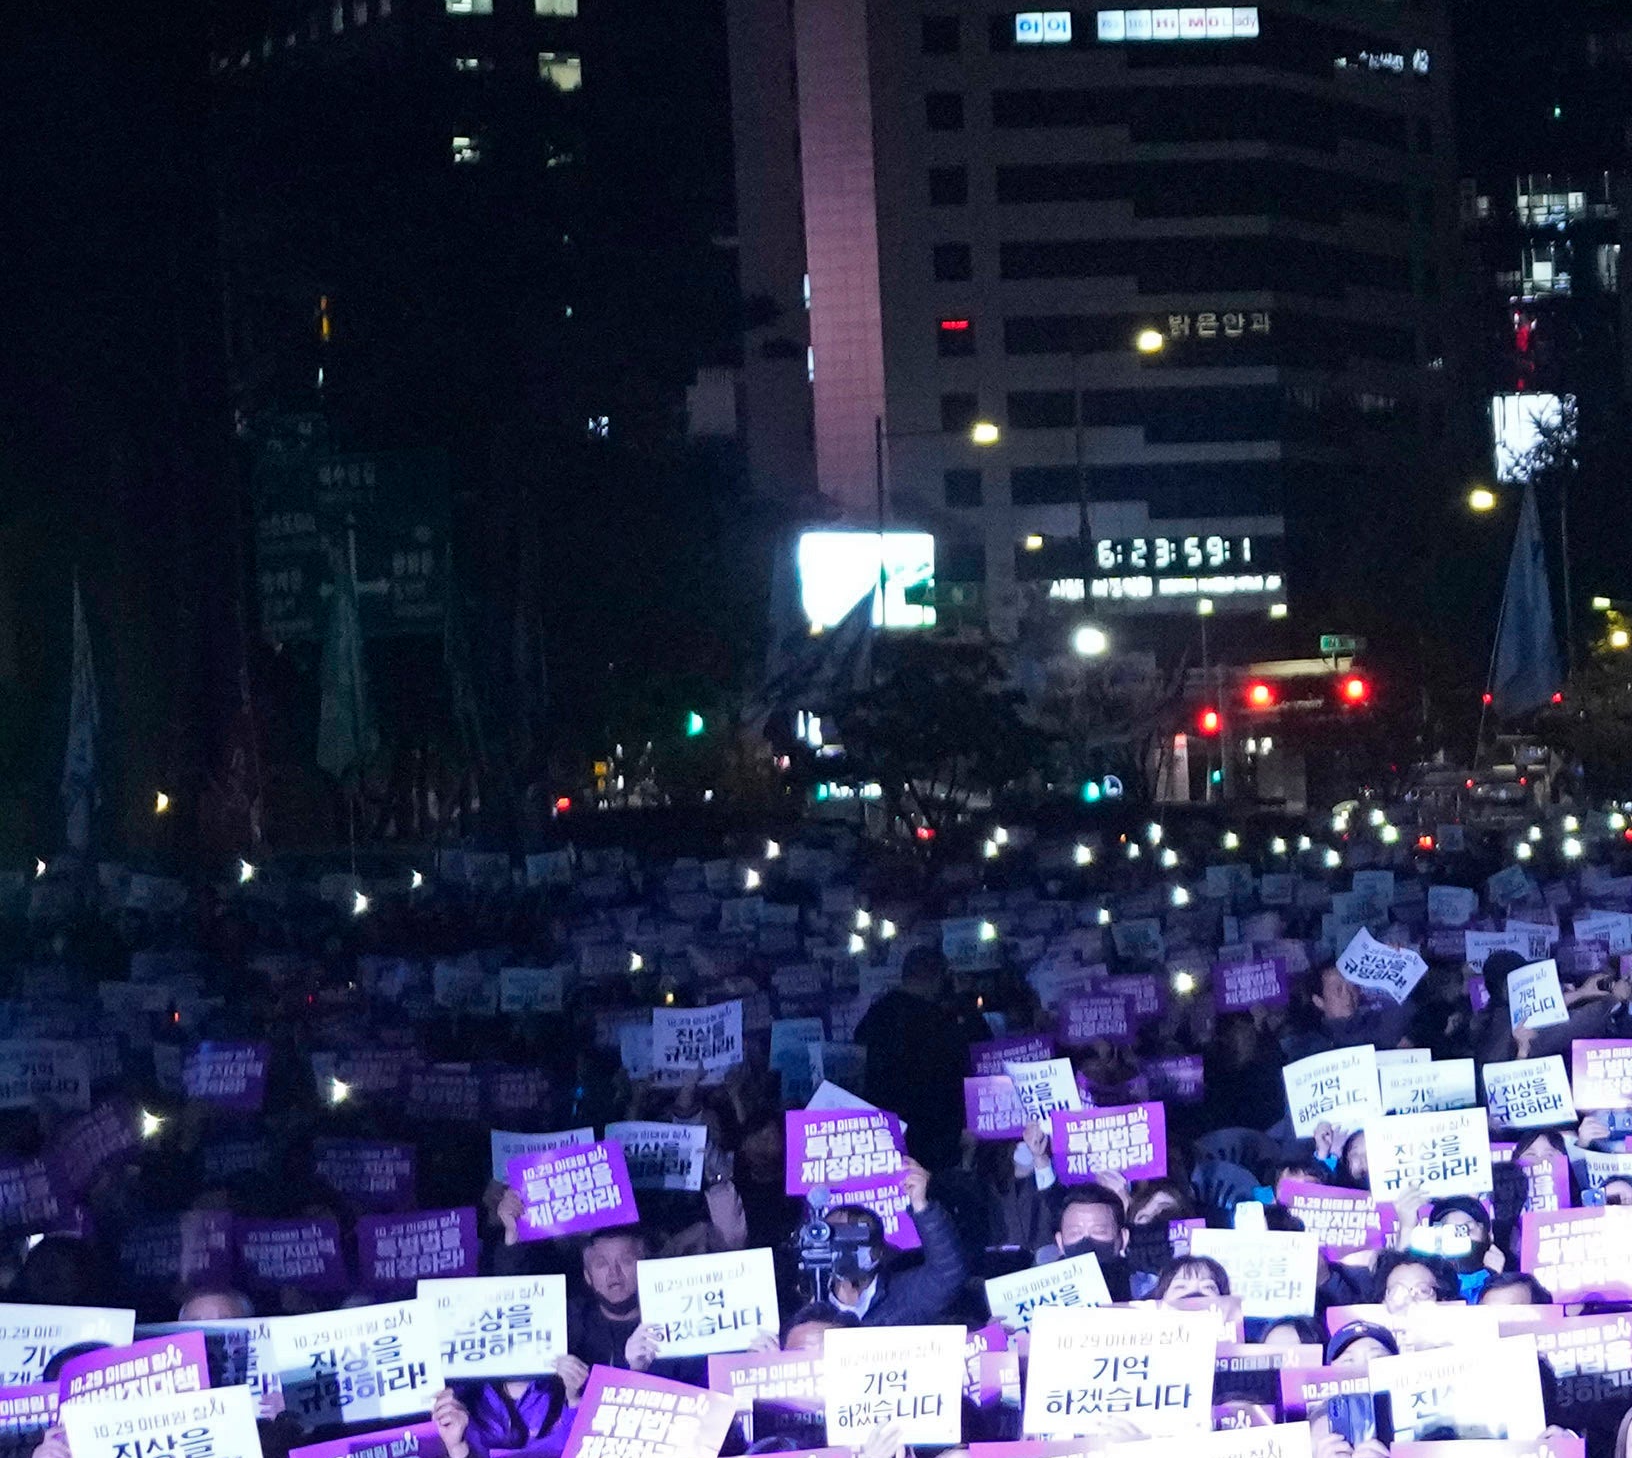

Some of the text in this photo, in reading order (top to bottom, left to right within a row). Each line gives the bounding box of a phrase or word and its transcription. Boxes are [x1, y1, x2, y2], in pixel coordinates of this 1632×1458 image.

[1168, 313, 1271, 339] 밝은안과
[1310, 1080, 1341, 1096] 기억
[1501, 1079, 1547, 1103] 진상을
[1495, 1098, 1564, 1120] 규명하라!
[804, 1132, 895, 1159] 특별법을
[1067, 1126, 1150, 1154] 특별법을
[1394, 1136, 1459, 1163] 진상을
[522, 1163, 552, 1181] 10.29
[802, 1155, 902, 1184] 제정하라!
[1065, 1144, 1154, 1174] 제정하라!
[525, 1167, 614, 1203] 특별법을
[1383, 1161, 1479, 1189] 규명하라!
[527, 1189, 621, 1228] 제정하라!
[680, 1291, 726, 1312] 기억
[864, 1369, 908, 1393] 기억
[1092, 1354, 1150, 1381] 기억
[1047, 1384, 1192, 1415] 하겠습니다
